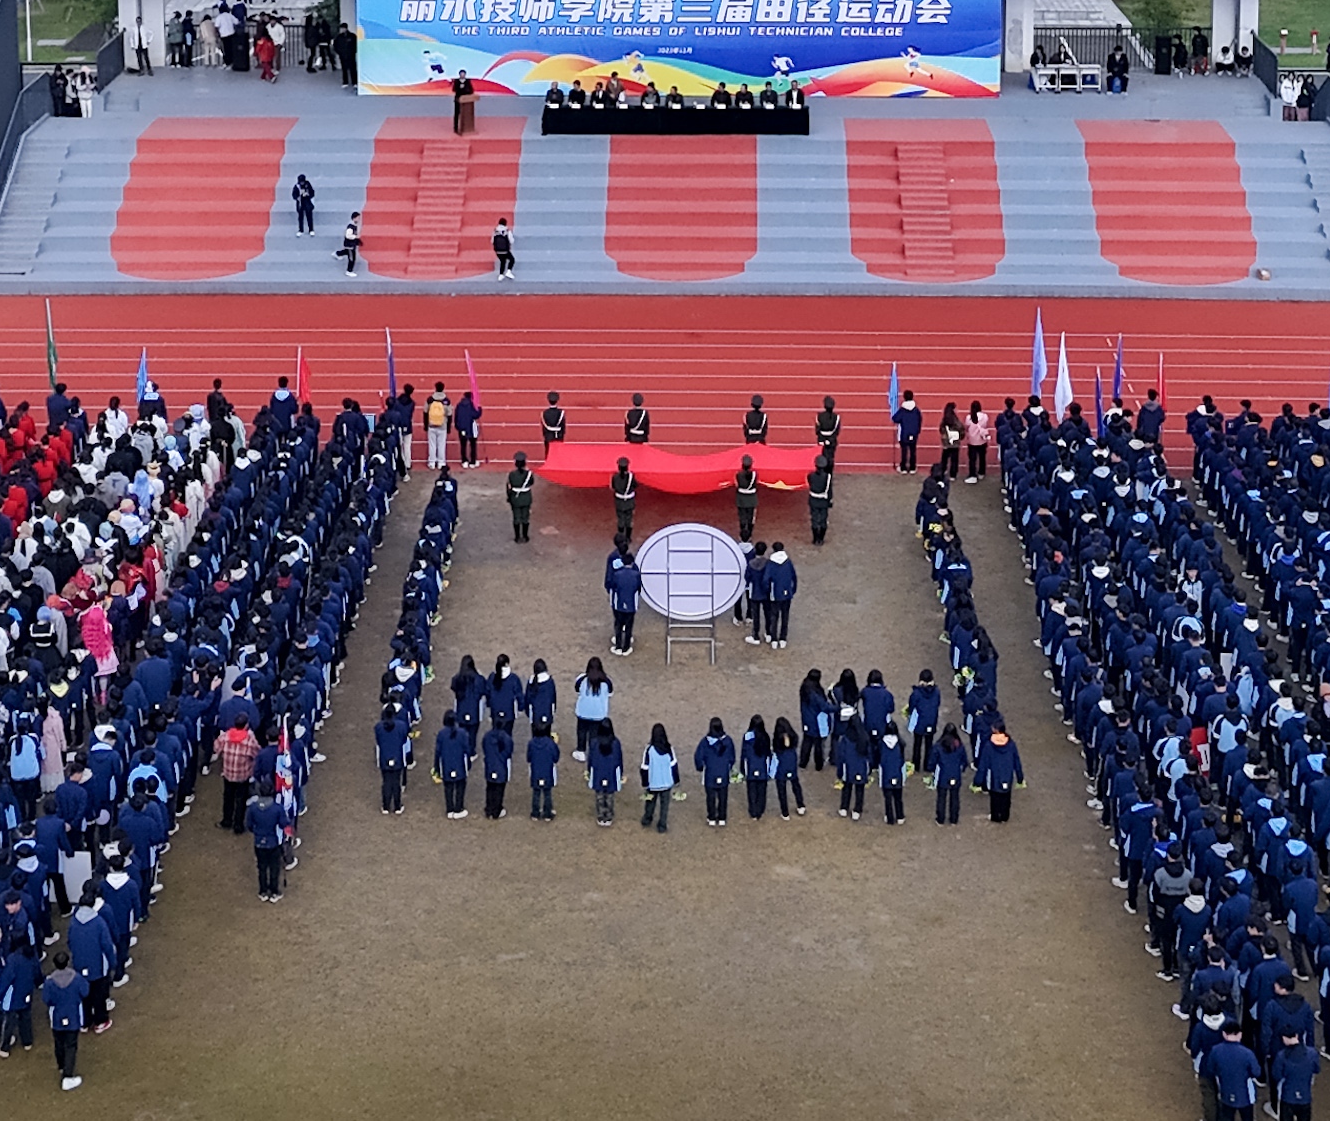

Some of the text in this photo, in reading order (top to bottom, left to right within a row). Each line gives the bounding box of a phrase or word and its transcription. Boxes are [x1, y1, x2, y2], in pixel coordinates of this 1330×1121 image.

[453, 26, 903, 36] THE THIRD ATHLETIC GAMES OF LISHUI TECHNICIAN COLLEGE
